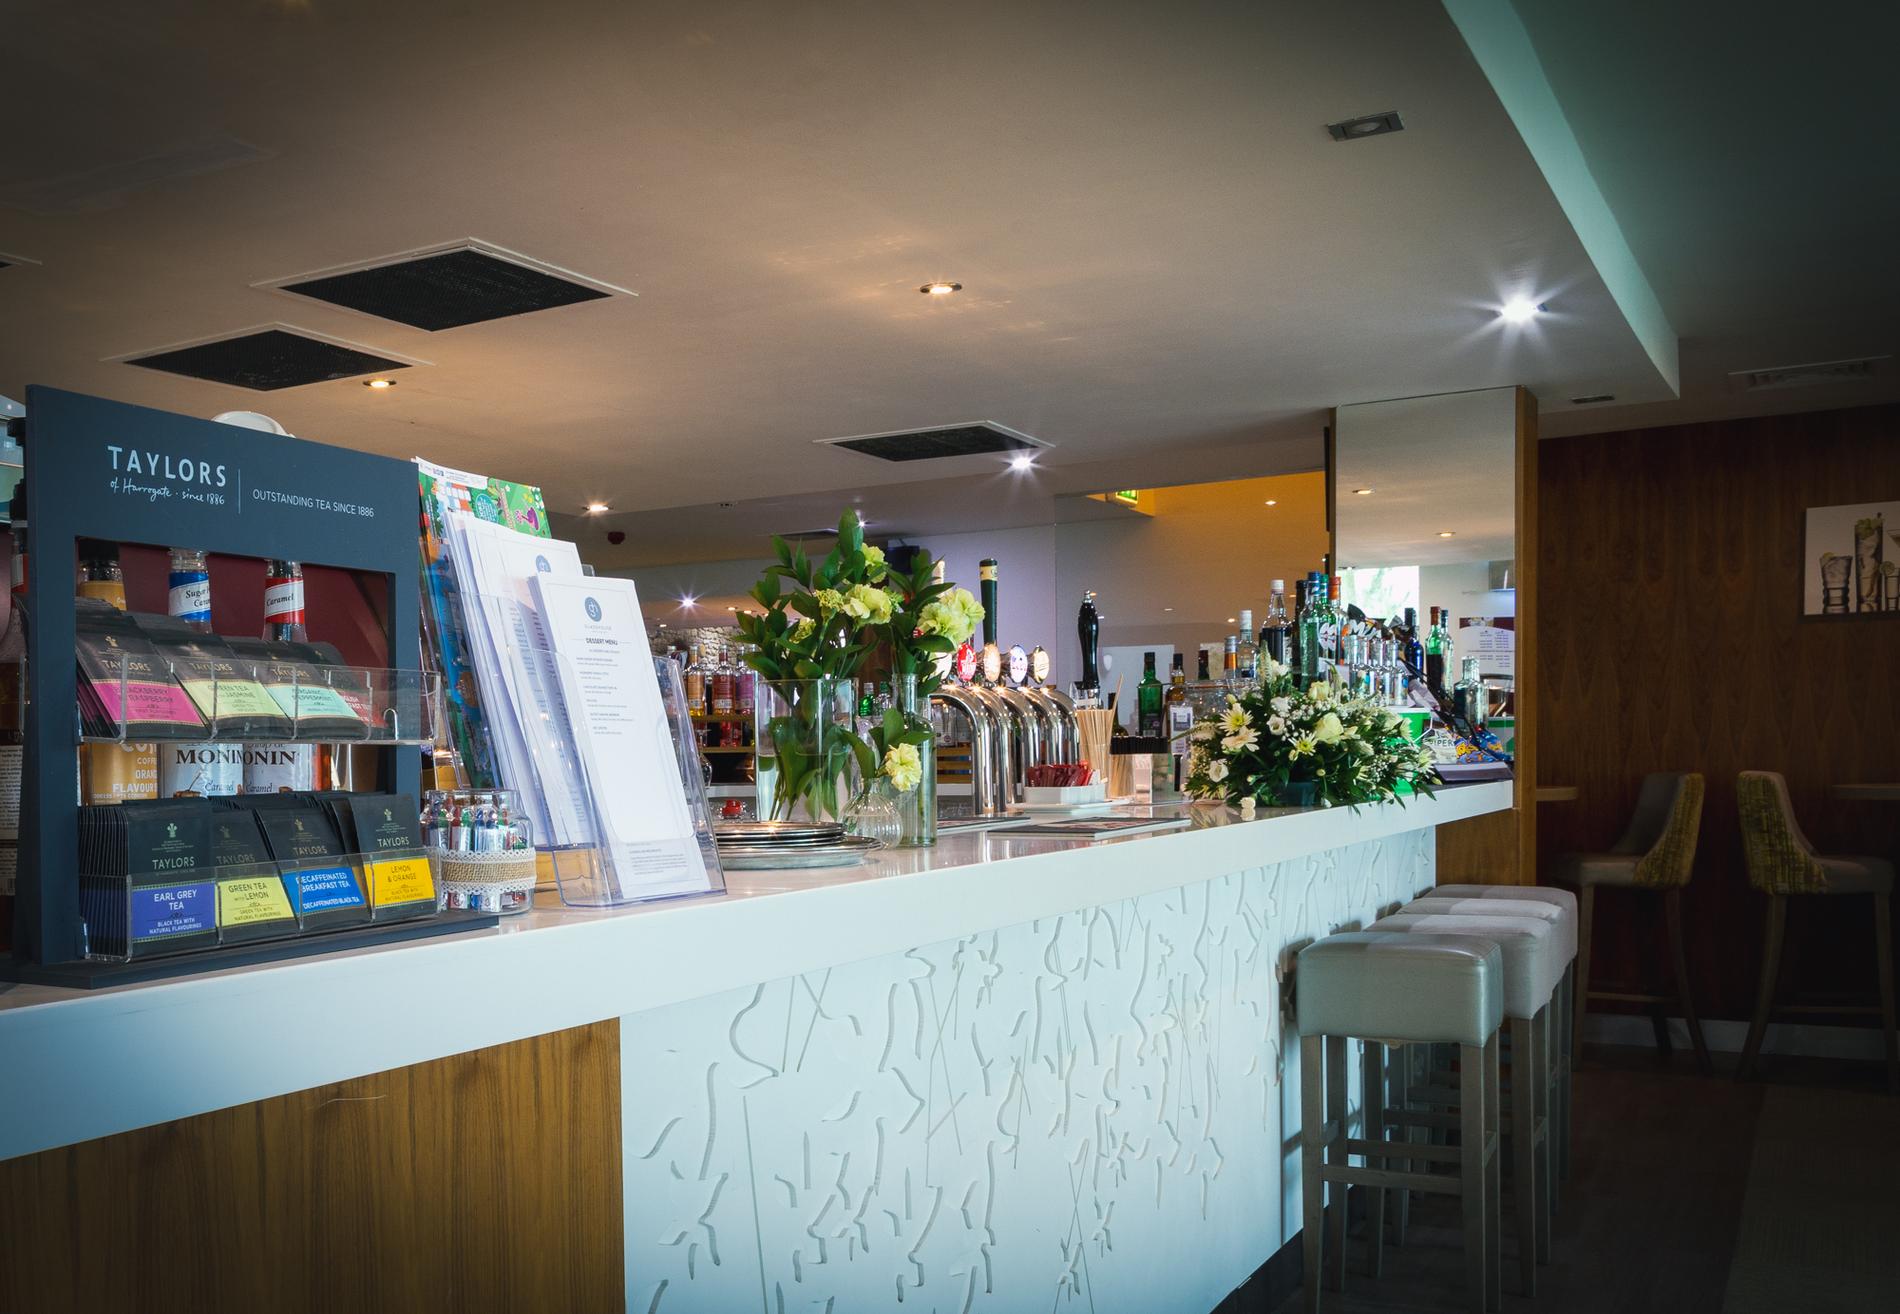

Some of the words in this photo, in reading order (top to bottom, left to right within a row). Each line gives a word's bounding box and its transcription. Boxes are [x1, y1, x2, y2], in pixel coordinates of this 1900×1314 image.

[107, 445, 226, 487] TAYLORS
[110, 476, 119, 493] of
[122, 477, 172, 503] Harrogate
[182, 488, 204, 502] since
[206, 493, 225, 506] 1886
[252, 488, 314, 508] OUTSTANDING
[315, 498, 332, 511] TEA
[332, 502, 357, 515] SINCE
[357, 505, 375, 518] 1886
[194, 598, 210, 608] Cara
[266, 592, 294, 607] Caramel
[102, 660, 151, 672] TAYORS
[189, 663, 232, 672] TAYORS
[243, 750, 296, 765] ONIN
[246, 782, 274, 793] Caramel
[377, 836, 410, 848] TAYLORS
[293, 844, 328, 856] TAYLORS
[152, 856, 195, 869] TAYLORS
[216, 853, 256, 865] TAYLORS
[390, 865, 411, 874] LEMON
[393, 873, 417, 882] ORANGE
[228, 883, 253, 894] GREEN
[253, 882, 268, 891] TEA
[337, 880, 351, 888] TEA
[154, 892, 176, 903] EARL
[177, 889, 198, 900] GREY
[245, 891, 270, 901] LEMON
[169, 901, 185, 911] TEA
[157, 920, 173, 928] BLACK
